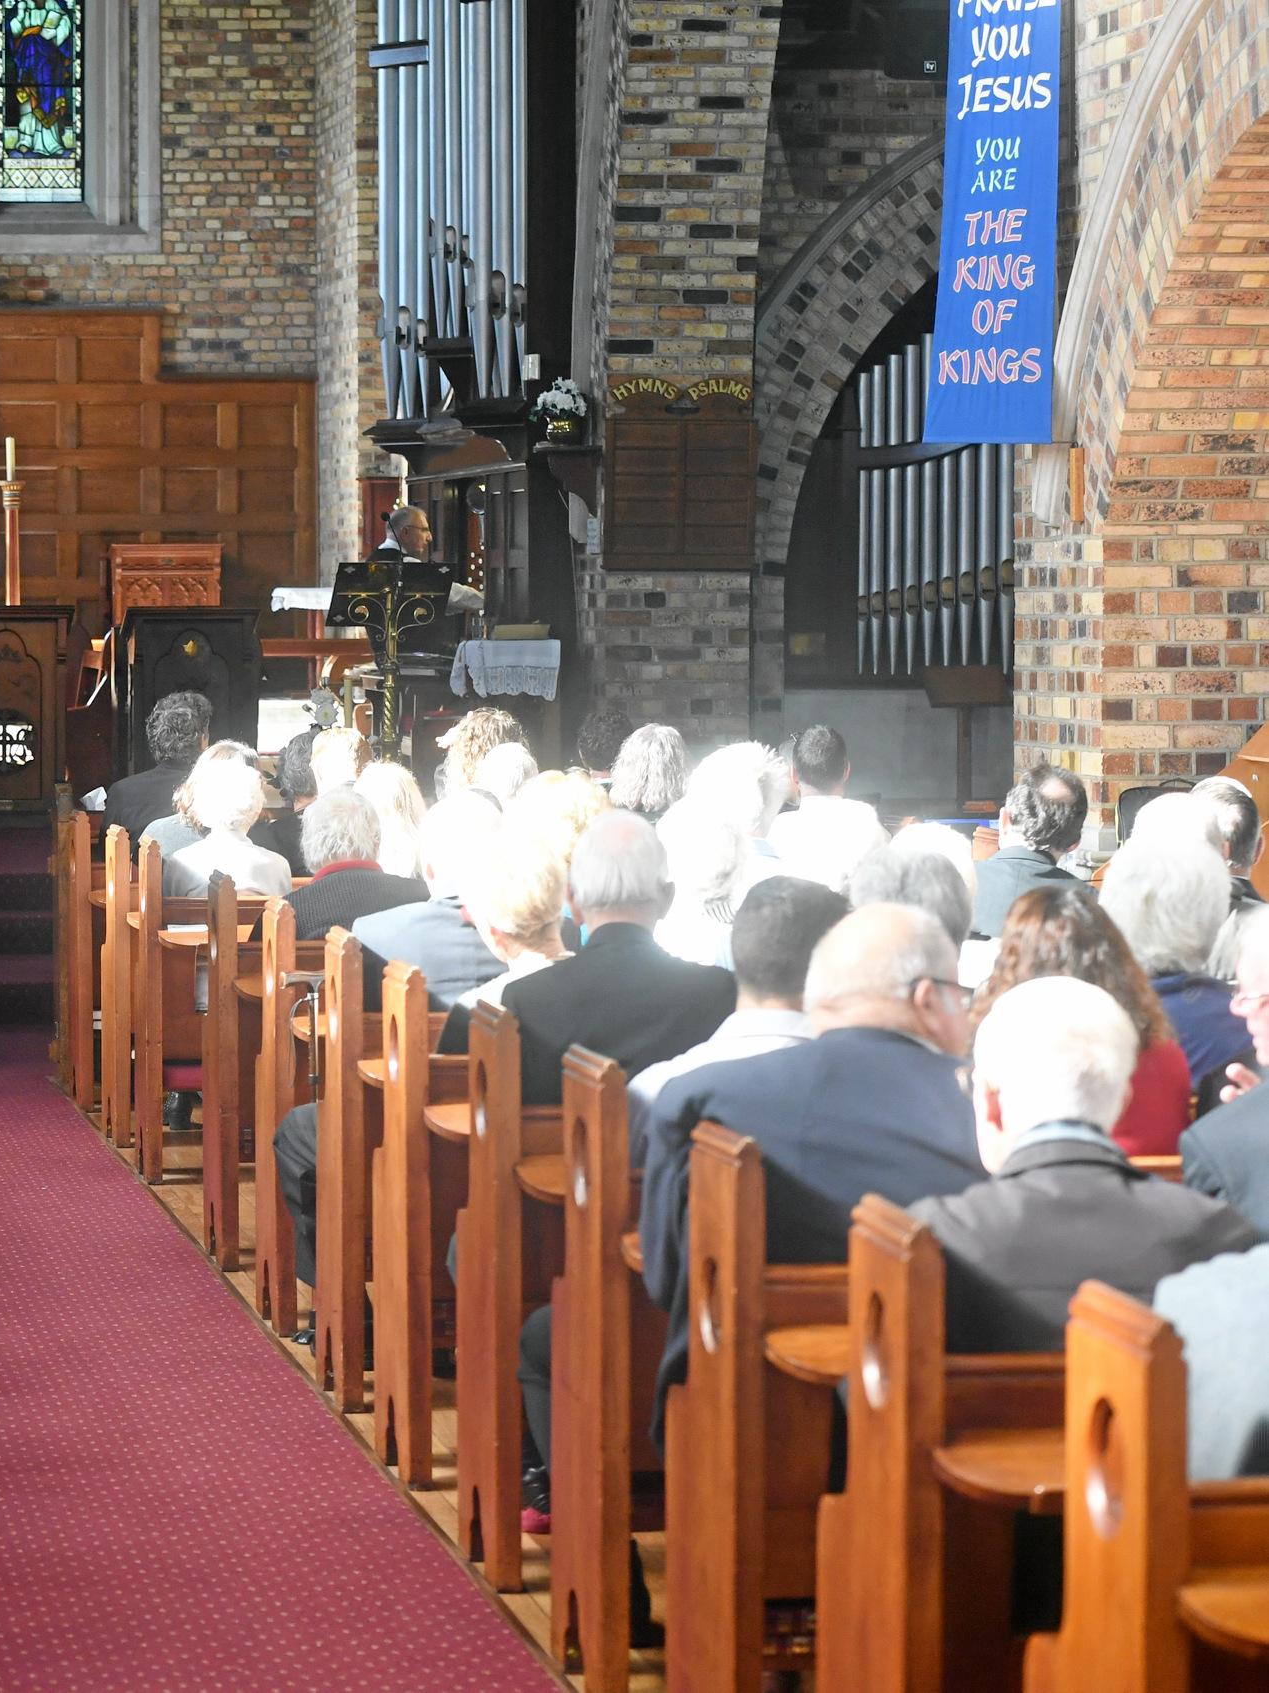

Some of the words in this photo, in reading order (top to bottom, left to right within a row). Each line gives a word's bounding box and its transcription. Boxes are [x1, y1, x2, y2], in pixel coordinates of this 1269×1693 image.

[971, 22, 1031, 68] YOU
[957, 73, 1051, 120] JESUS
[975, 136, 1021, 165] YOU
[970, 168, 1017, 194] ARE
[964, 208, 1027, 247] THE
[953, 253, 1035, 293] KING
[972, 299, 1017, 335] OF
[938, 346, 1042, 385] KINGS
[612, 378, 677, 400] HYMNS
[688, 379, 750, 401] PSALMS
